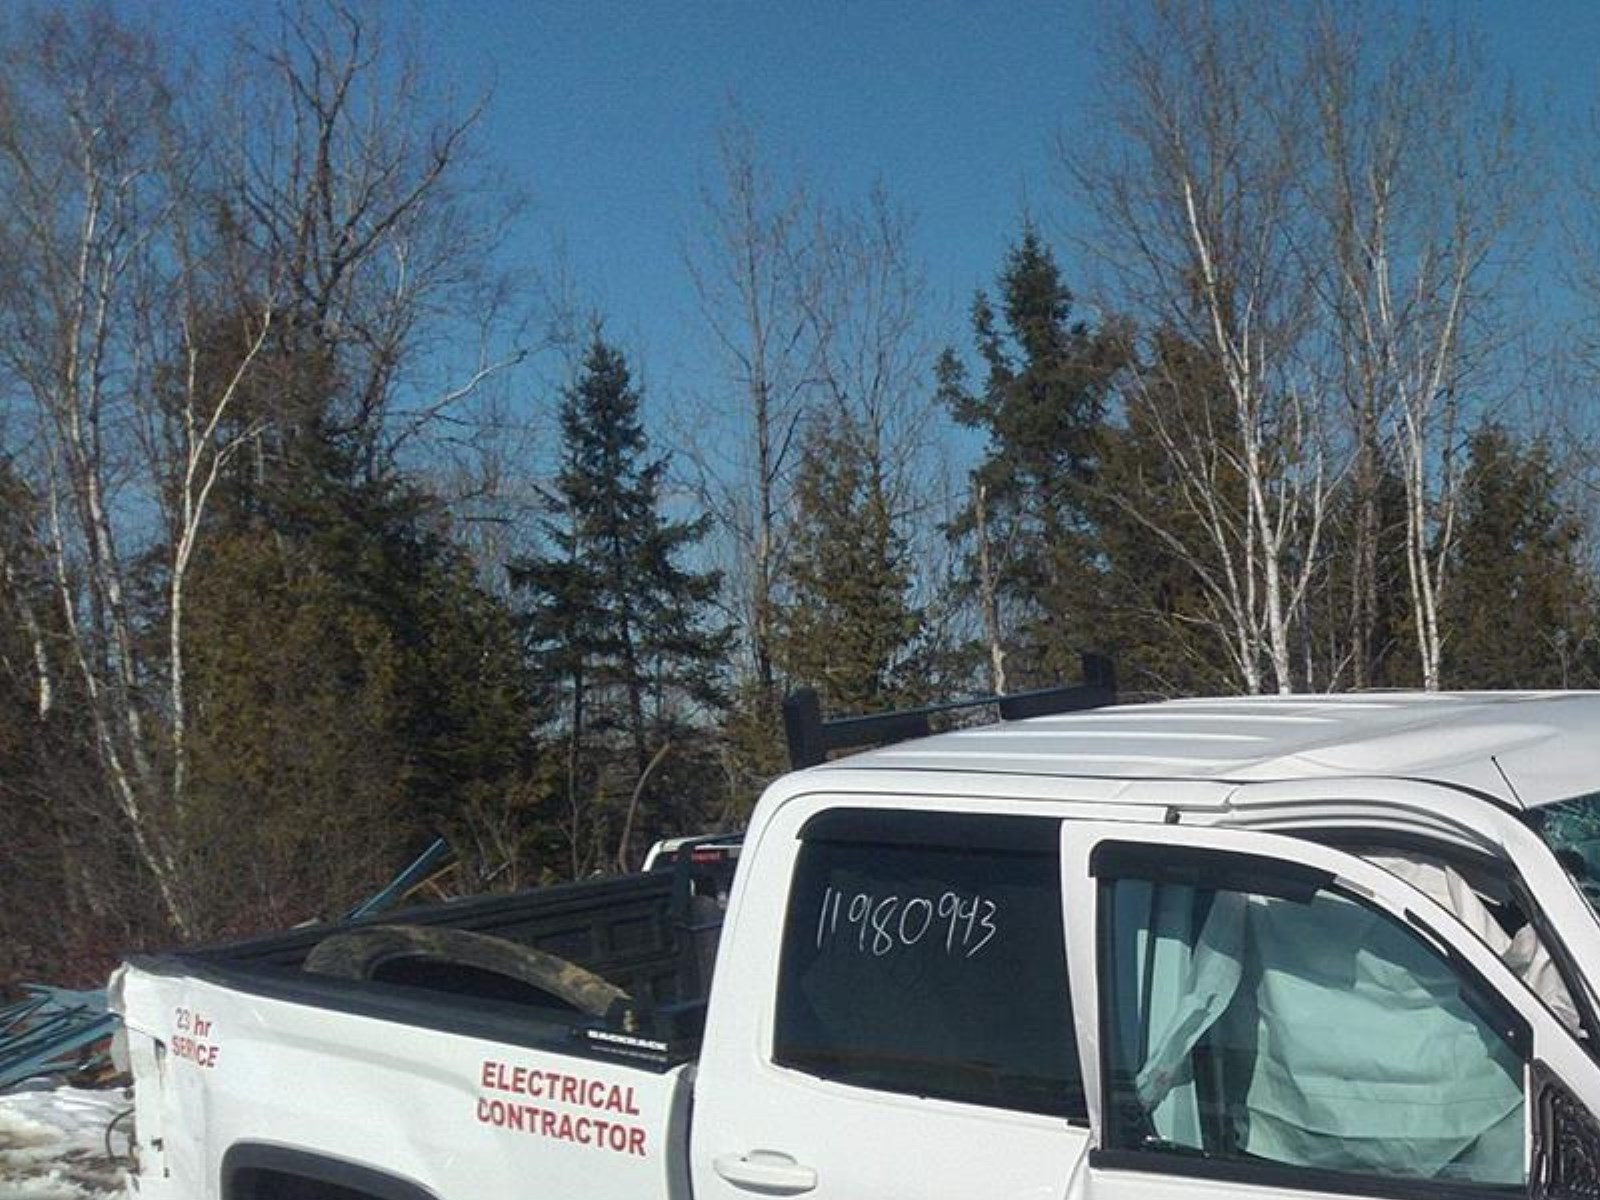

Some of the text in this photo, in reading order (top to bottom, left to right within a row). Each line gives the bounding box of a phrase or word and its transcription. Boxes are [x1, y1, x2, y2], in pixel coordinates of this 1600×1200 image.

[816, 887, 997, 957] 11980943
[194, 1013, 212, 1037] hr
[482, 1061, 641, 1116] ELECTRICAL
[476, 1097, 648, 1157] CONTRACTOR
